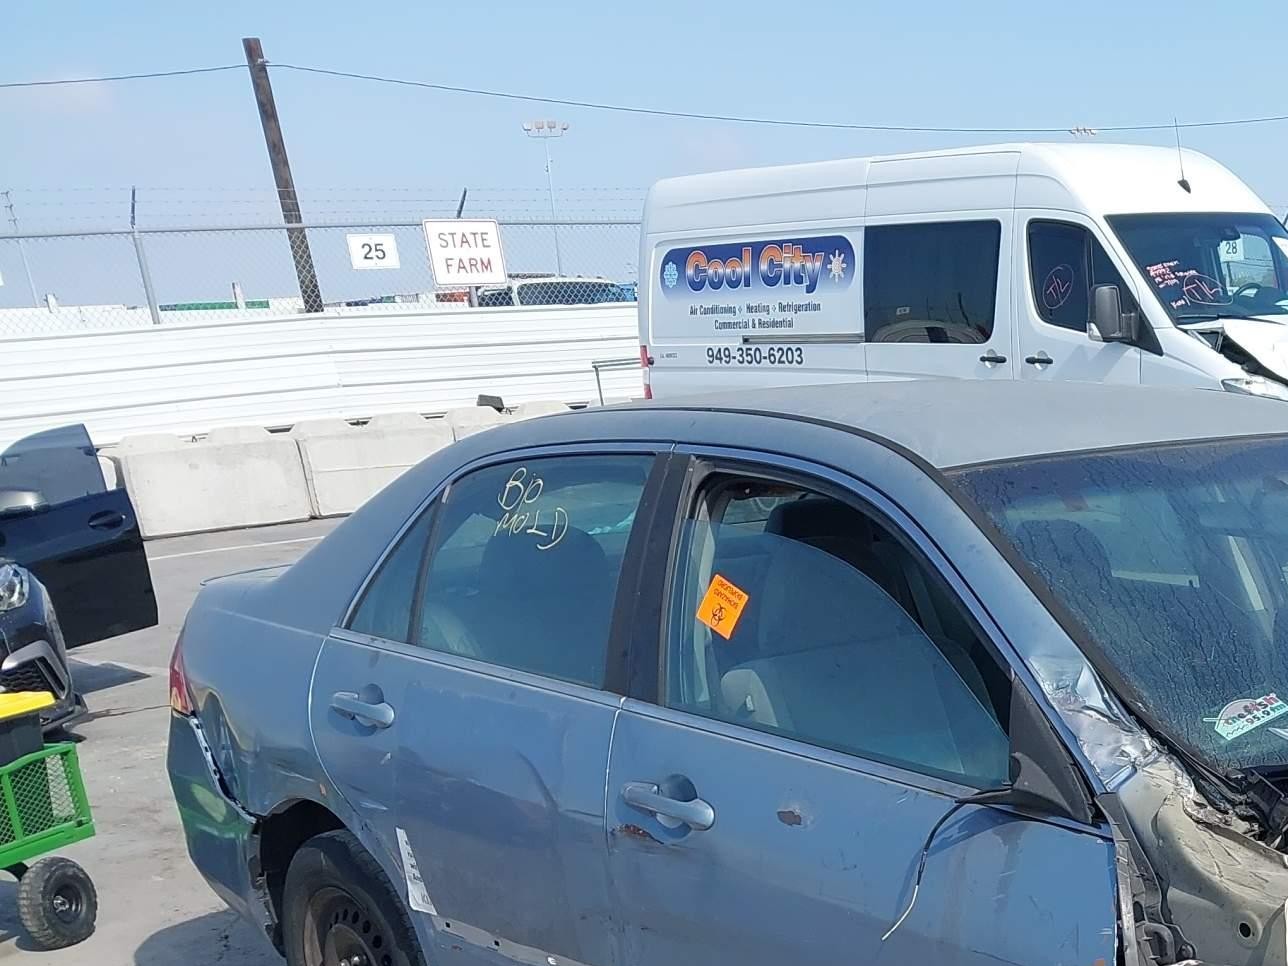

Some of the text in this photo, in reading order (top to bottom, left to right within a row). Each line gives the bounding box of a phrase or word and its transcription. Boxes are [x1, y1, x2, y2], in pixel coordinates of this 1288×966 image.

[437, 232, 491, 249] STATE
[1225, 241, 1238, 255] 28
[361, 243, 386, 260] 25
[445, 257, 493, 274] FARM
[685, 243, 824, 294] Cool City
[689, 301, 821, 317] Air Conditioning Heating Refrigeration
[714, 317, 794, 331] Commercial & Residential
[706, 346, 804, 365] 949-350-6203
[1245, 709, 1271, 726] 95.9
